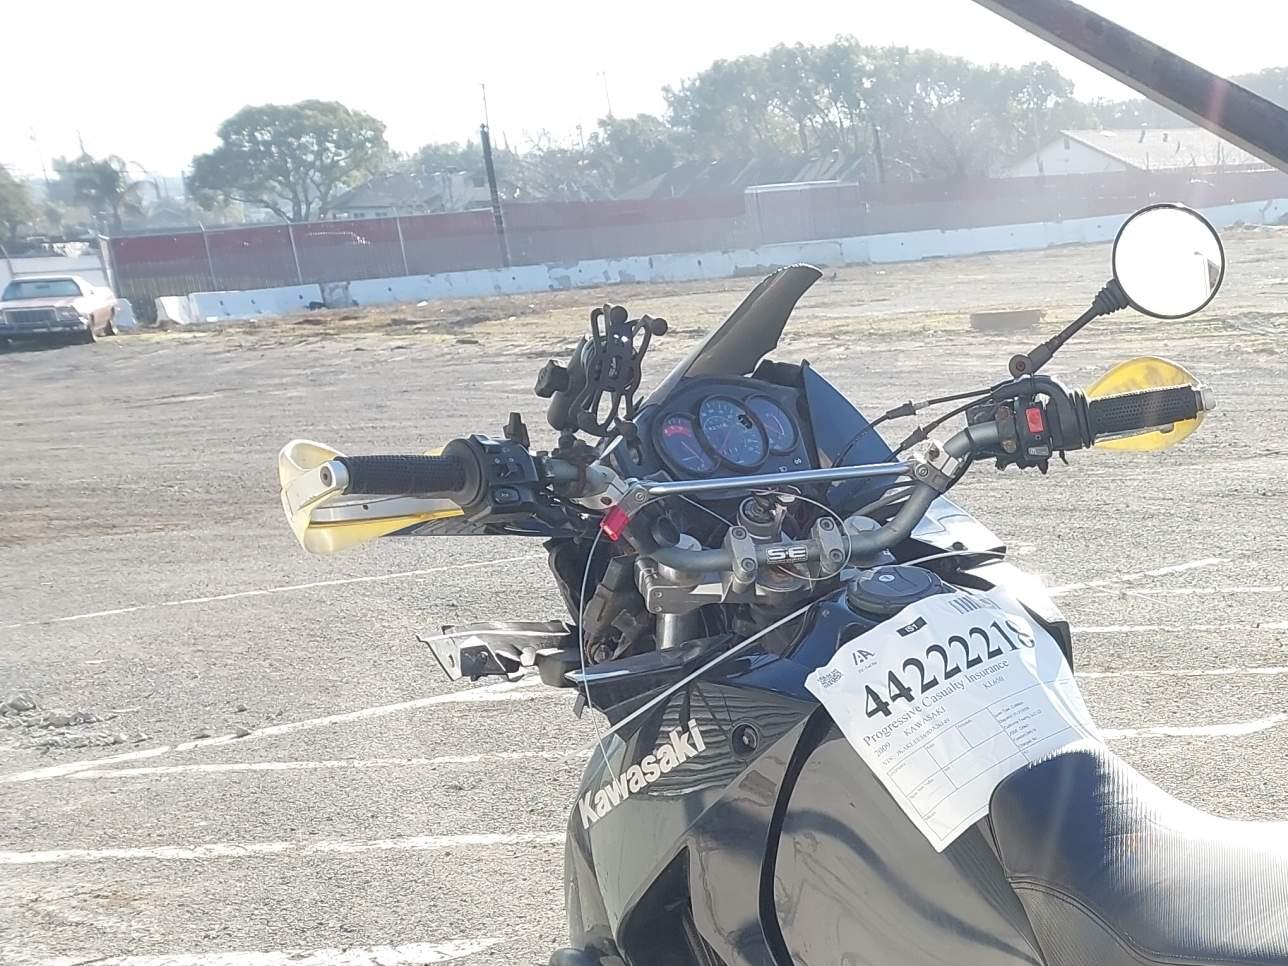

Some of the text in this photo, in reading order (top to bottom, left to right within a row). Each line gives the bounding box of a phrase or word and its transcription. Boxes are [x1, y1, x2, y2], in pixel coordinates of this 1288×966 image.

[863, 705, 923, 746] Progressive
[921, 680, 965, 707] Casualty
[964, 660, 1009, 684] Insurance
[865, 620, 1035, 718] 44222218
[903, 705, 946, 737] KAWASAKI
[578, 718, 707, 829] Kawasaki
